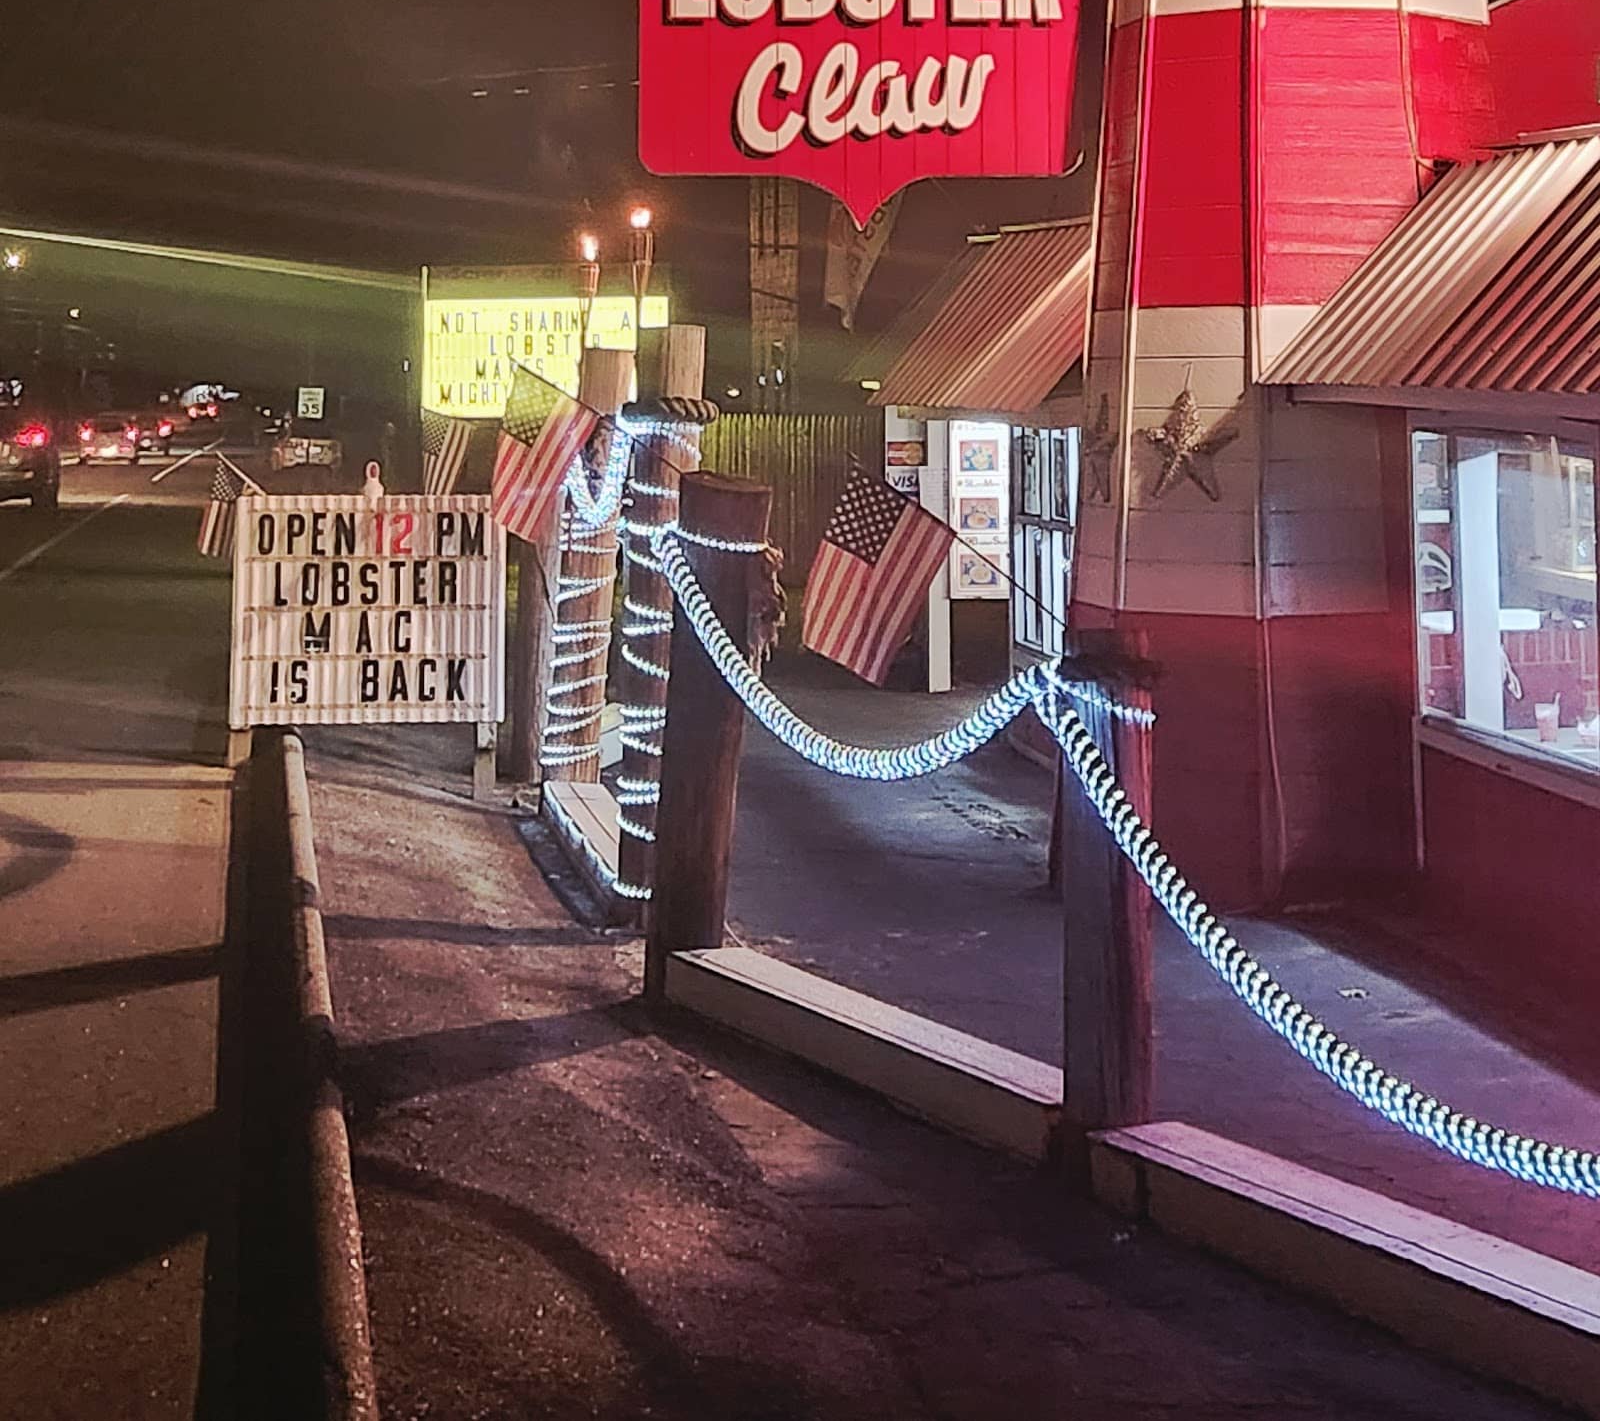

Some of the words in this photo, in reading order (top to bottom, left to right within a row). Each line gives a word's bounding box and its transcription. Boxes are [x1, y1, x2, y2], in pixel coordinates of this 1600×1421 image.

[733, 42, 994, 156] Claw
[440, 311, 479, 333] NOT
[510, 310, 587, 332] SHARIN
[490, 334, 600, 356] LOBSTR
[892, 475, 919, 488] VIS
[257, 512, 356, 556] OPEN
[373, 511, 413, 555] 12
[436, 512, 485, 555] PM
[273, 560, 458, 607] LOBSTER
[303, 610, 412, 654] MAC
[269, 659, 308, 704] IS
[360, 659, 467, 703] BACK
